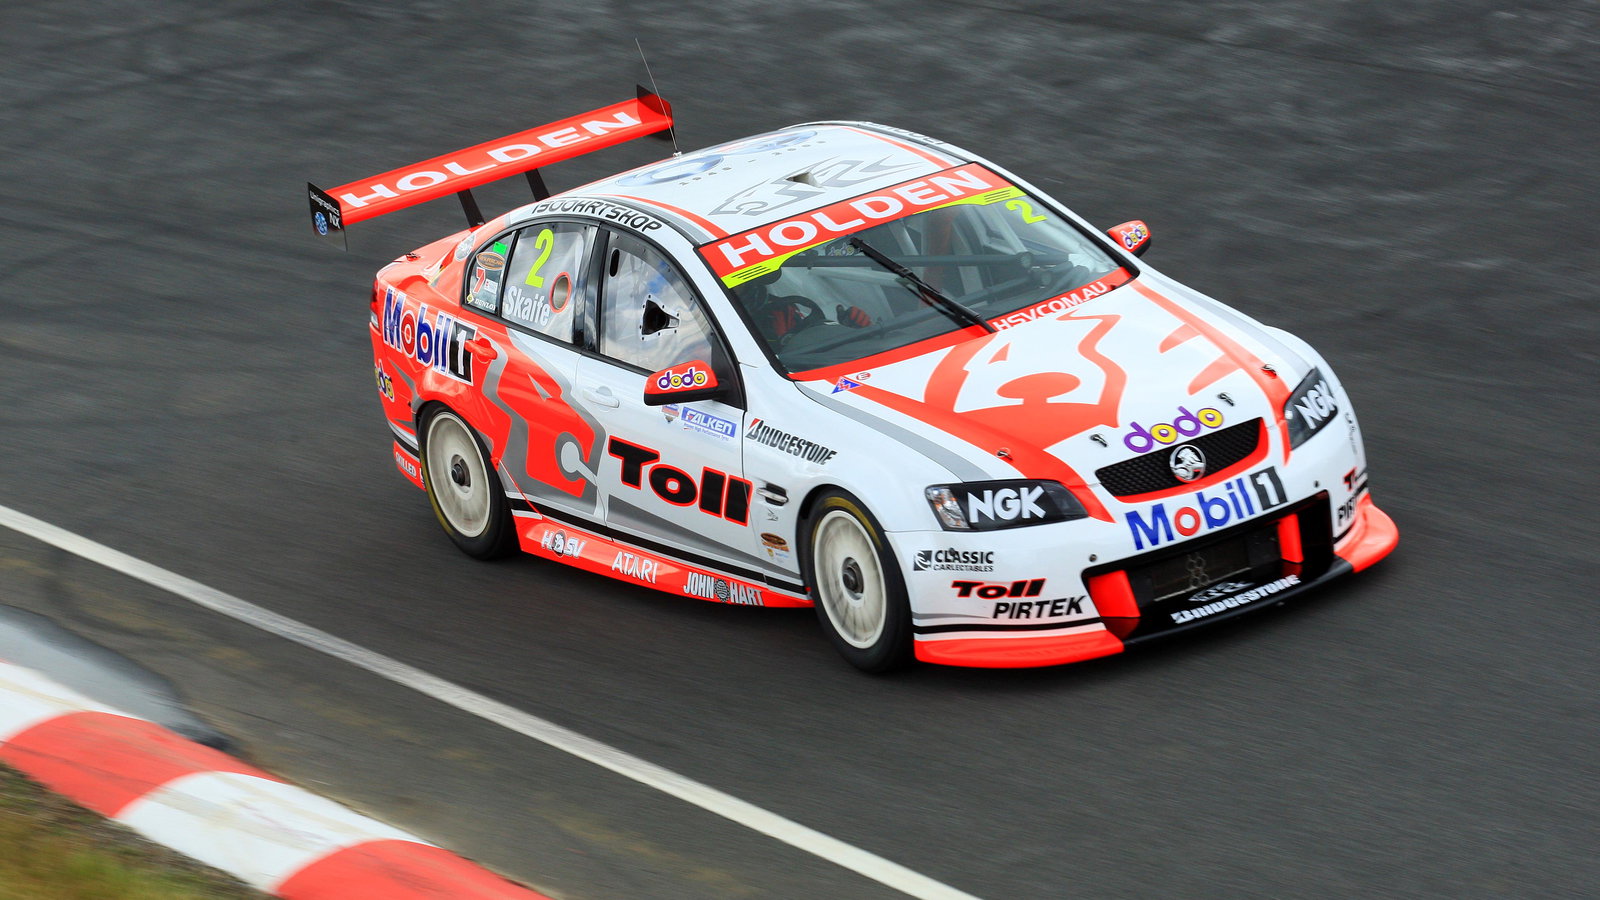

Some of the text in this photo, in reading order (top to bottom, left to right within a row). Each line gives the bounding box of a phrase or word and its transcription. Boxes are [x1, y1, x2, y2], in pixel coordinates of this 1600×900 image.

[340, 112, 642, 208] HOLDEN
[718, 170, 991, 268] HOLDEN
[1005, 199, 1049, 225] 2
[1120, 223, 1149, 250] dodo
[525, 228, 554, 289] 2
[505, 285, 551, 326] Skaife
[383, 285, 451, 374] Mobil
[656, 366, 709, 391] dodo
[685, 409, 733, 435] FALKEN
[1294, 379, 1339, 430] NGK
[745, 417, 838, 465] BRIDGESTONE
[1123, 405, 1225, 454] dodo
[608, 434, 753, 528] Toll
[967, 485, 1047, 524] NGK
[1124, 477, 1255, 551] Mobil
[611, 551, 658, 584] ATARI
[933, 563, 994, 573] CARLECTABLES
[934, 548, 994, 564] CLASSIC
[683, 571, 765, 607] JOHN HART
[951, 578, 1047, 600] Toll
[993, 595, 1087, 620] PIRTEK
[1169, 574, 1302, 625] BRIDGESTONE
